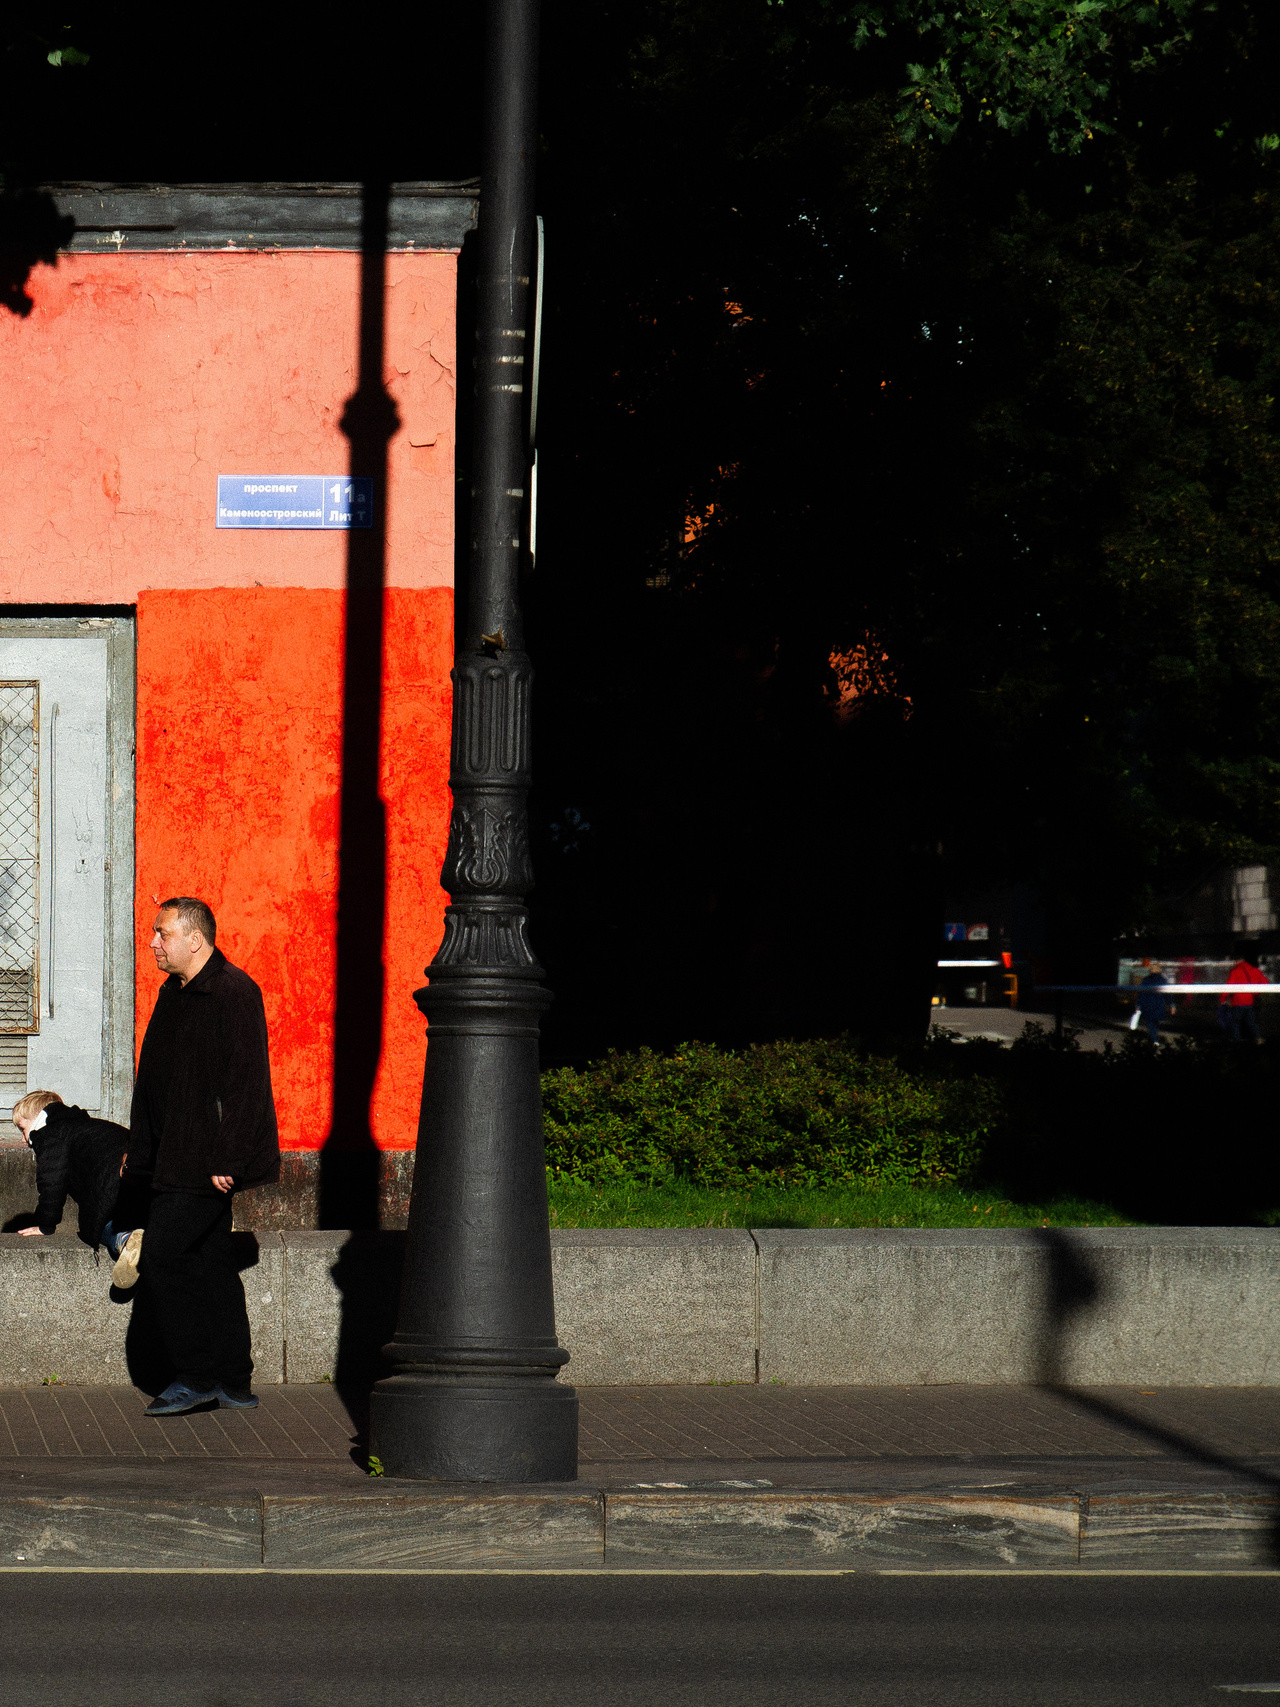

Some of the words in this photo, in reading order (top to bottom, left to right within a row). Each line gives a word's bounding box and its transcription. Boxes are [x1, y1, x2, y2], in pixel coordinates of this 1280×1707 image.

[243, 484, 299, 495] проспект
[219, 507, 322, 519] Каменоостровский
[329, 510, 354, 522] Лит
